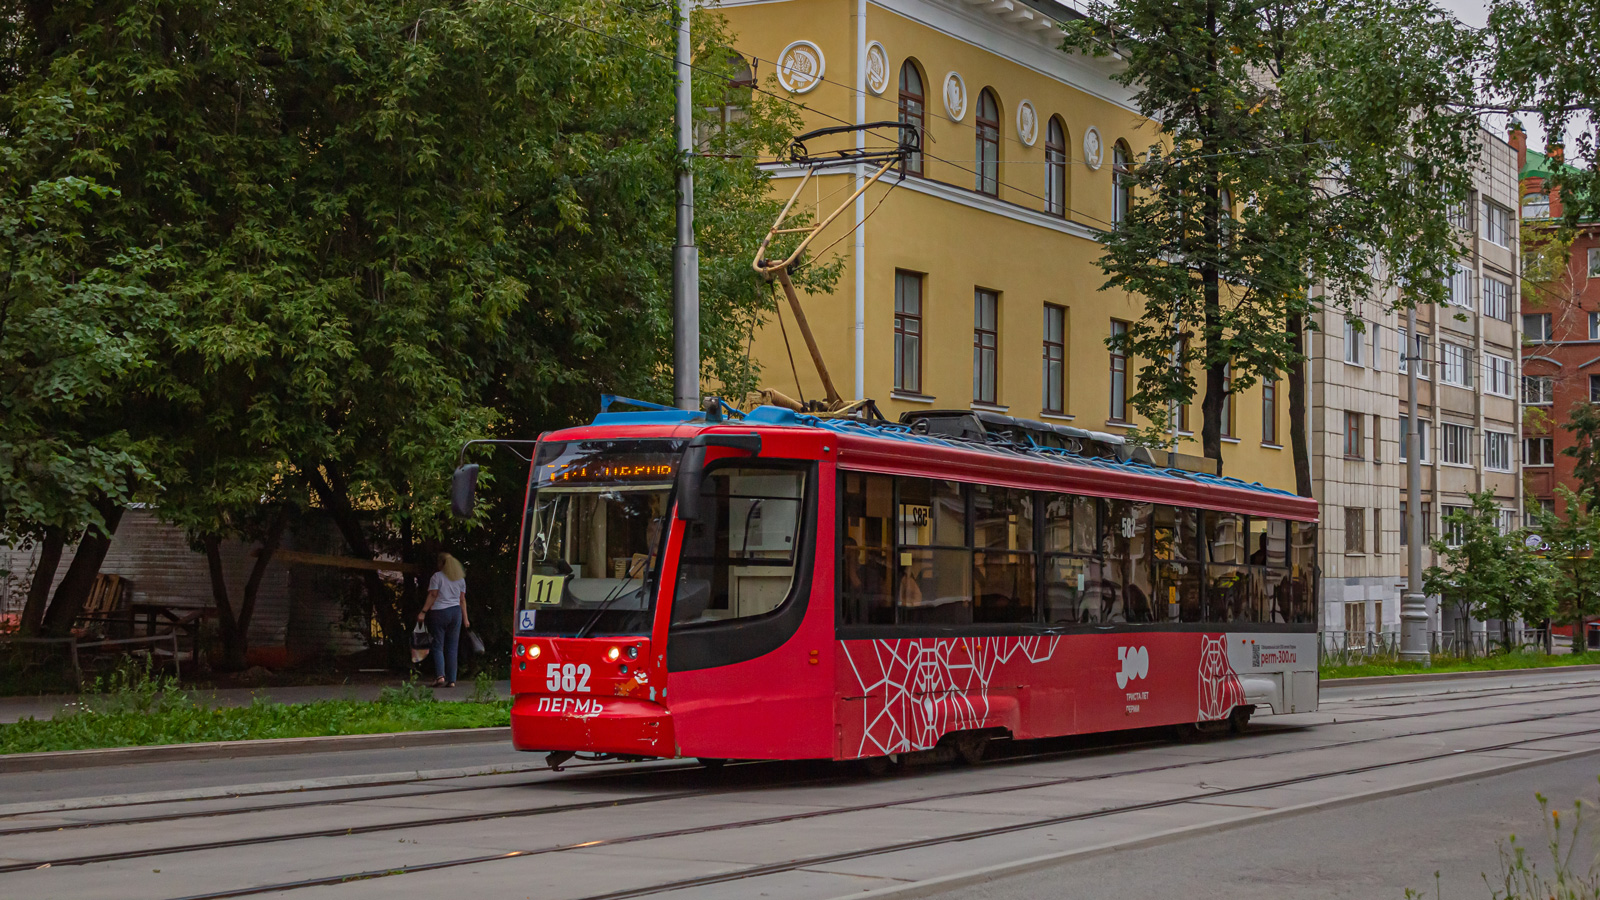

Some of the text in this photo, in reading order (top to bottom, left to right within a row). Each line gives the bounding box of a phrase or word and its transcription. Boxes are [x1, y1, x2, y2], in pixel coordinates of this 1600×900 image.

[1121, 517, 1136, 538] 582
[534, 579, 554, 603] 11
[1116, 646, 1149, 690] 300
[1261, 650, 1297, 667] perm-300.ru
[546, 663, 592, 693] 582
